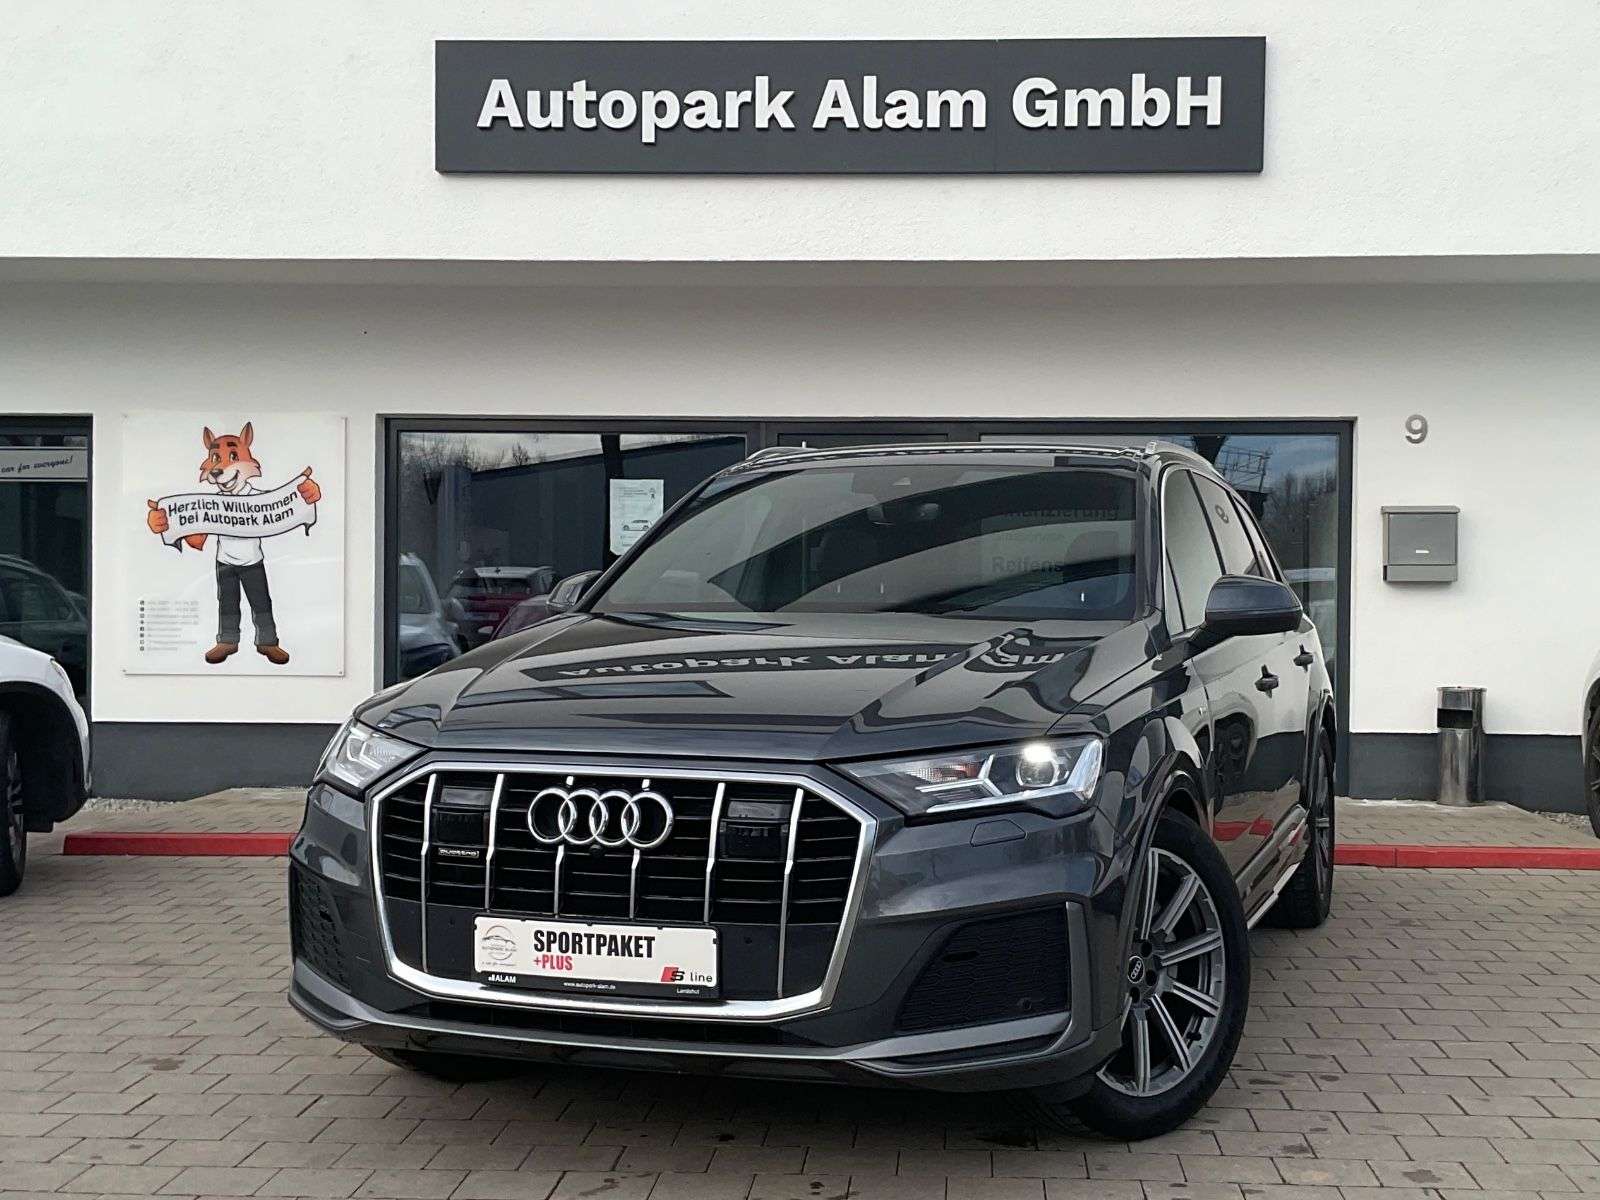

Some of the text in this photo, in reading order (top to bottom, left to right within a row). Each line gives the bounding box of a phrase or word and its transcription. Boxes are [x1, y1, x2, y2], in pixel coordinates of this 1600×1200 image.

[478, 72, 1223, 144] Autopark Alam GmbH
[1405, 414, 1429, 444] 9
[168, 491, 299, 518] Herzlich Willkommen
[179, 507, 295, 528] bei Autopark Alam
[533, 929, 656, 959] SPORTPAKET
[533, 954, 574, 971] +PLUS
[495, 973, 517, 984] ALAM
[671, 970, 713, 983] S line
